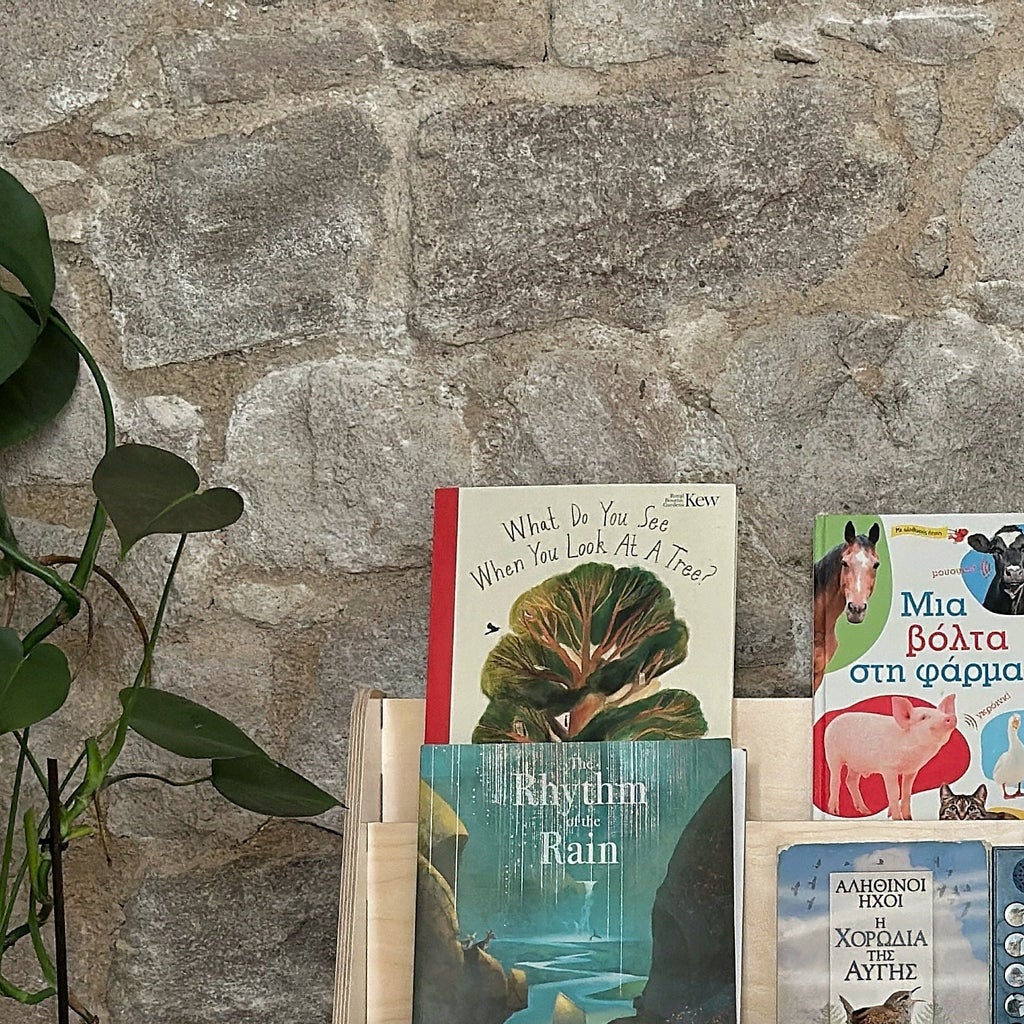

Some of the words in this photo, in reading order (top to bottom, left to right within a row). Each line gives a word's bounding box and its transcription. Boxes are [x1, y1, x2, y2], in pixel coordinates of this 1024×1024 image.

[685, 493, 720, 507] Kew
[502, 507, 560, 542] What
[571, 503, 588, 527] Do
[600, 501, 628, 527] You
[638, 505, 669, 532] See
[470, 558, 525, 591] When
[528, 543, 560, 566] You
[567, 529, 607, 559] Look
[614, 534, 638, 557] At
[644, 540, 663, 563] A
[665, 544, 718, 585] Tree?
[901, 592, 967, 617] Μια
[906, 623, 1008, 658] βόλτα
[850, 662, 906, 683] στη
[916, 657, 1023, 688] φάρμα
[569, 756, 594, 769] The
[512, 771, 647, 816] Rhythm
[567, 816, 581, 827] of
[581, 815, 601, 827] the
[541, 832, 619, 865] Rain
[835, 878, 926, 894] ΑΛΗΘΙΝΟΙ
[858, 894, 903, 909] ΗΧΟΙ
[875, 917, 886, 929] Η
[834, 927, 928, 948] ΧΟΡΩΔΙΑ
[867, 949, 895, 961] ΤΗΣ
[844, 959, 917, 981] ΑΥΓΗΣ
